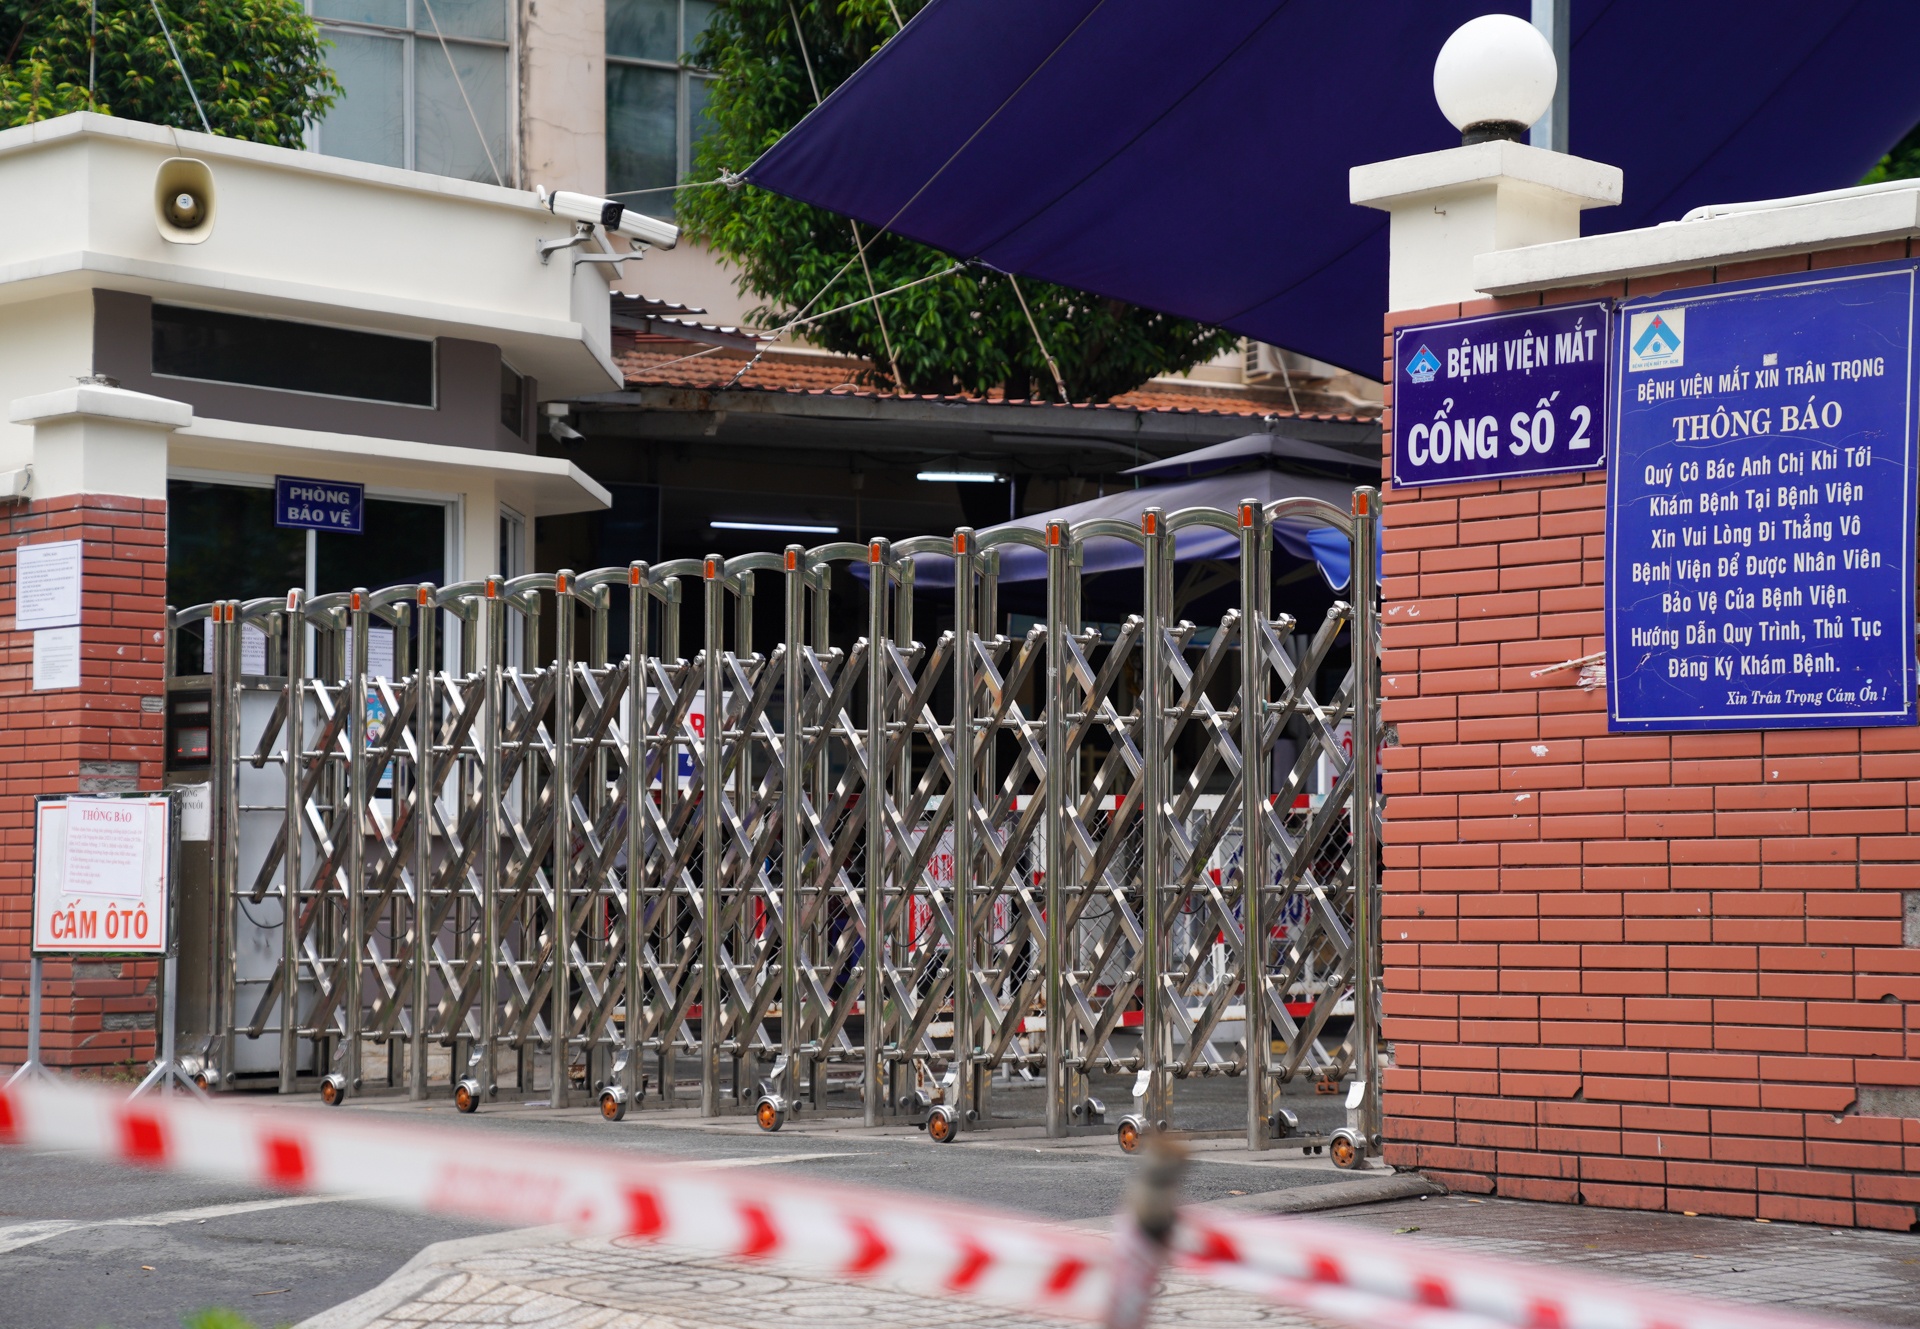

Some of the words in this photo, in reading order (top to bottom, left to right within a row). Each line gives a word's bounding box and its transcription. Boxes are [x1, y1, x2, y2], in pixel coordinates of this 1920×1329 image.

[1448, 338, 1497, 382] BỆNH
[1504, 329, 1549, 375] VIỆN
[1555, 317, 1597, 364] MẮT
[1638, 378, 1674, 404] BỆNH
[1681, 373, 1712, 398] VIỆN
[1719, 365, 1749, 392] MẮT
[1755, 369, 1779, 388] XIN
[1785, 361, 1825, 385] TRÂN
[1832, 357, 1884, 382] TRỌNG
[1408, 398, 1498, 466] CỔNG
[1509, 391, 1560, 455] SỐ
[1569, 406, 1590, 449] 2
[1673, 405, 1771, 442] THÔNG
[1780, 395, 1842, 432] BÁO
[1645, 463, 1673, 487] Quý
[1680, 462, 1698, 482] Cô
[1707, 458, 1734, 479] Bác
[1741, 455, 1770, 476] Anh
[1779, 452, 1803, 475] Chị
[1812, 450, 1837, 470] Khi
[1845, 446, 1871, 467] Tới
[289, 486, 350, 505] PHÒNG
[1650, 495, 1692, 516] Khám
[1700, 491, 1738, 515] Bệnh
[1745, 488, 1770, 512] Tại
[1778, 485, 1818, 509] Bệnh
[1826, 482, 1863, 505] Viện
[287, 503, 324, 522] BẢO
[329, 509, 351, 527] VỆ
[1652, 529, 1675, 548] Xin
[1683, 526, 1706, 546] Vui
[1714, 524, 1751, 547] Lòng
[1759, 521, 1775, 541] Đi
[1783, 513, 1832, 541] Thẳng
[1840, 515, 1860, 535] Vô
[1633, 562, 1669, 585] Bệnh
[1677, 559, 1710, 582] Viện
[1718, 552, 1740, 577] Để
[1746, 556, 1786, 578] Được
[1794, 552, 1835, 572] Nhân
[1843, 549, 1880, 569] Viên
[1663, 591, 1691, 612] Bảo
[1698, 591, 1717, 614] Vệ
[1725, 587, 1754, 610] Của
[1763, 587, 1802, 611] Bệnh
[1632, 626, 1678, 649] Hướng
[1687, 621, 1716, 644] Dẫn
[1724, 623, 1752, 646] Quy
[1759, 620, 1805, 642] Trình,
[1814, 616, 1842, 638] Thủ
[1851, 617, 1881, 640] Tục
[1669, 659, 1707, 681] Đăng
[1715, 656, 1733, 680] Ký
[1741, 654, 1785, 675] Khám
[1794, 653, 1840, 676] Bệnh.
[1726, 691, 1747, 704] Xin
[1752, 691, 1781, 704] Trân
[1786, 690, 1823, 705] Trọng
[1860, 686, 1877, 701] Ơn
[1882, 687, 1887, 700] !
[82, 807, 112, 822] THÔNG
[114, 808, 132, 823] BÁO
[50, 899, 97, 939] CẤM
[105, 902, 148, 939] ÔTÔ
